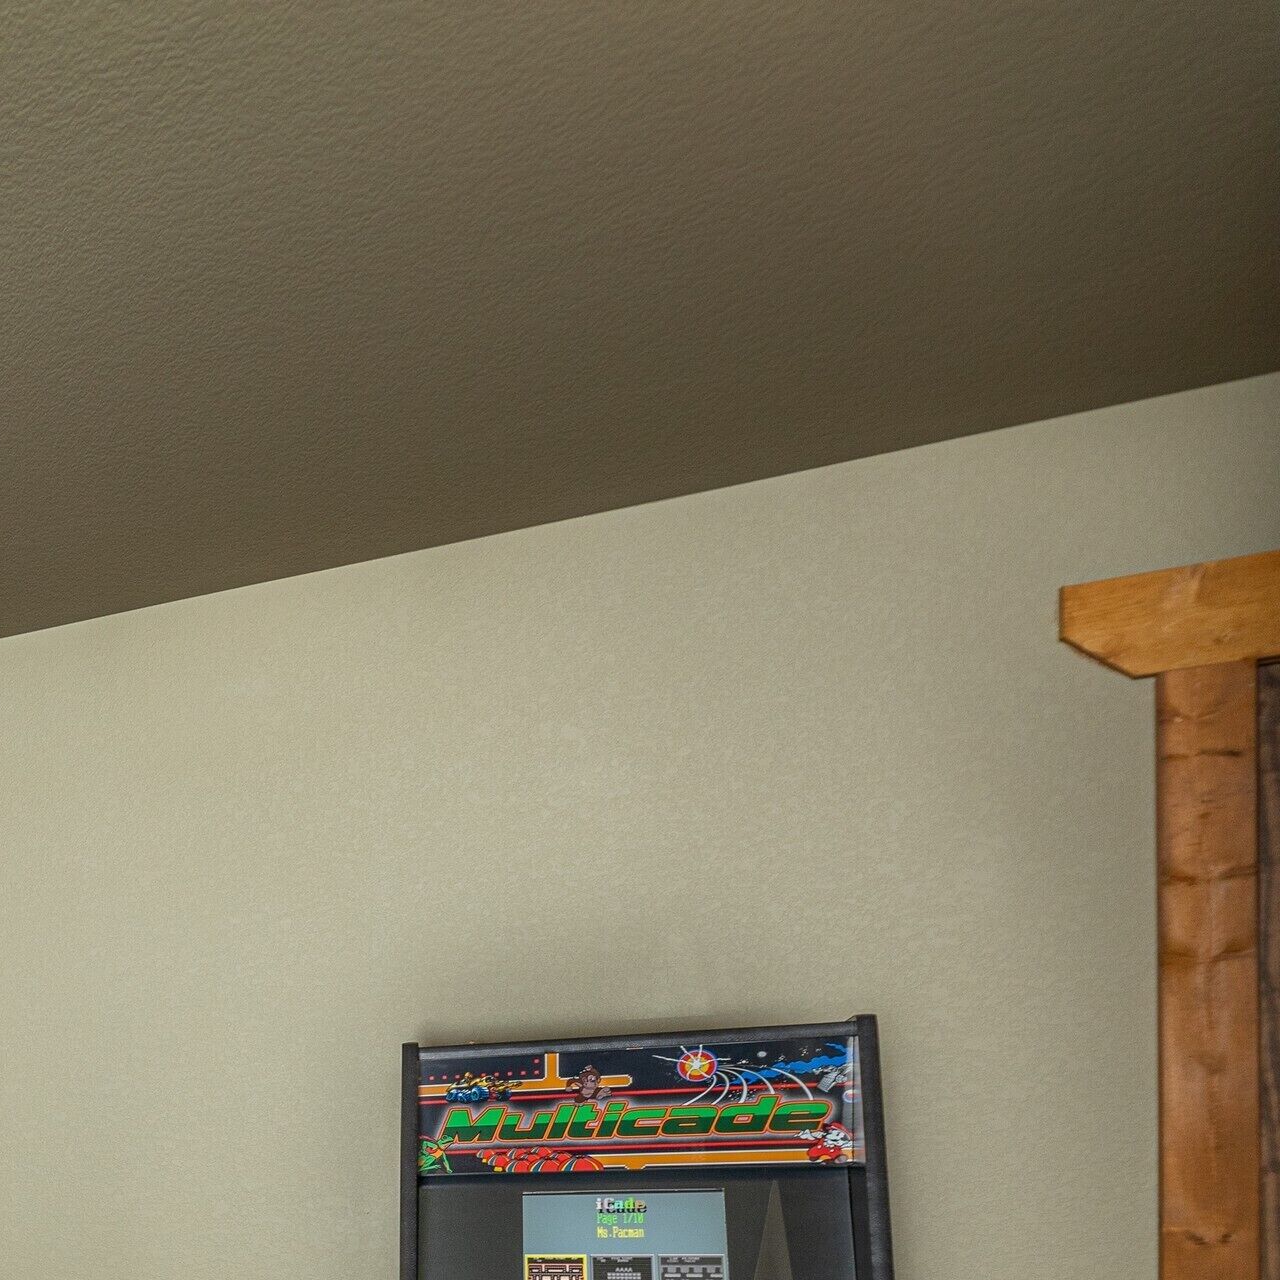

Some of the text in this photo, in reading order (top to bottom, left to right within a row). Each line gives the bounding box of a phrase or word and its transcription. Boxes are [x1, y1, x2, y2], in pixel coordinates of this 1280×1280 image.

[441, 1094, 833, 1143] Multicade
[596, 1197, 646, 1212] iCade
[597, 1213, 617, 1225] Page
[597, 1227, 645, 1238] Ms.Pacman
